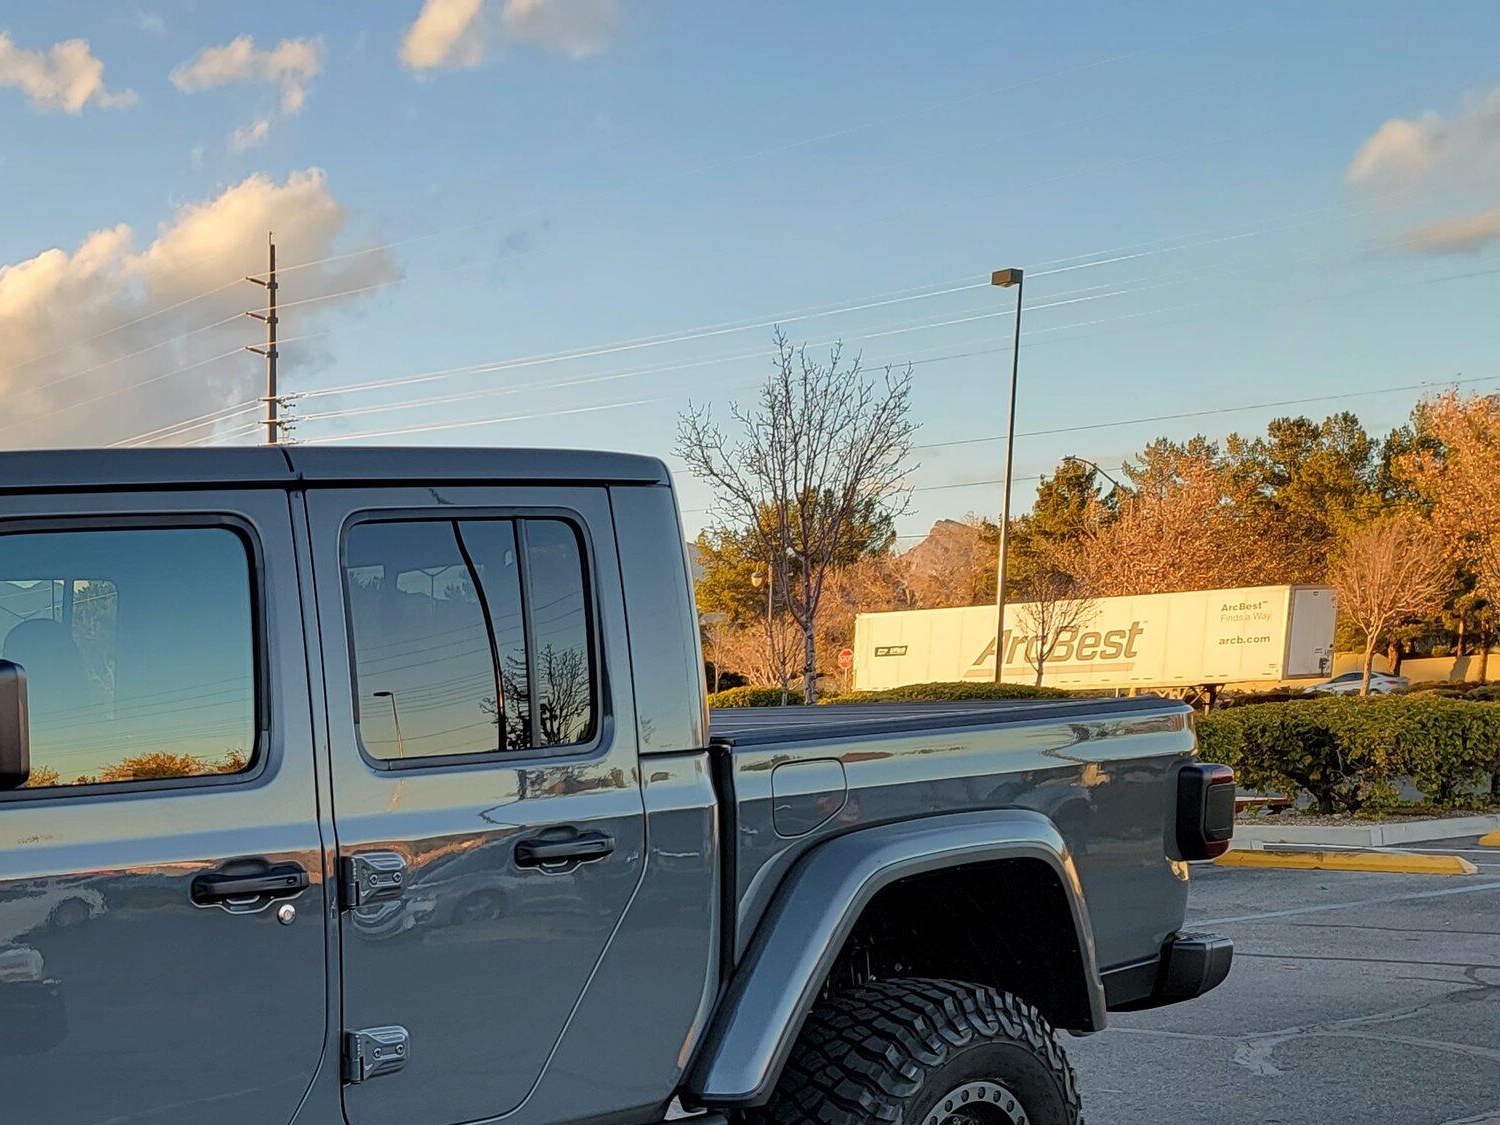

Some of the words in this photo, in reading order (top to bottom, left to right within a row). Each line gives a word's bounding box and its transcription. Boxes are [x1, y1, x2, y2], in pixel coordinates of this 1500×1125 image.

[1221, 600, 1262, 612] ArcBest
[1220, 613, 1243, 622] Finds
[972, 621, 1145, 666] ArcBest
[1218, 634, 1271, 646] arcb.com
